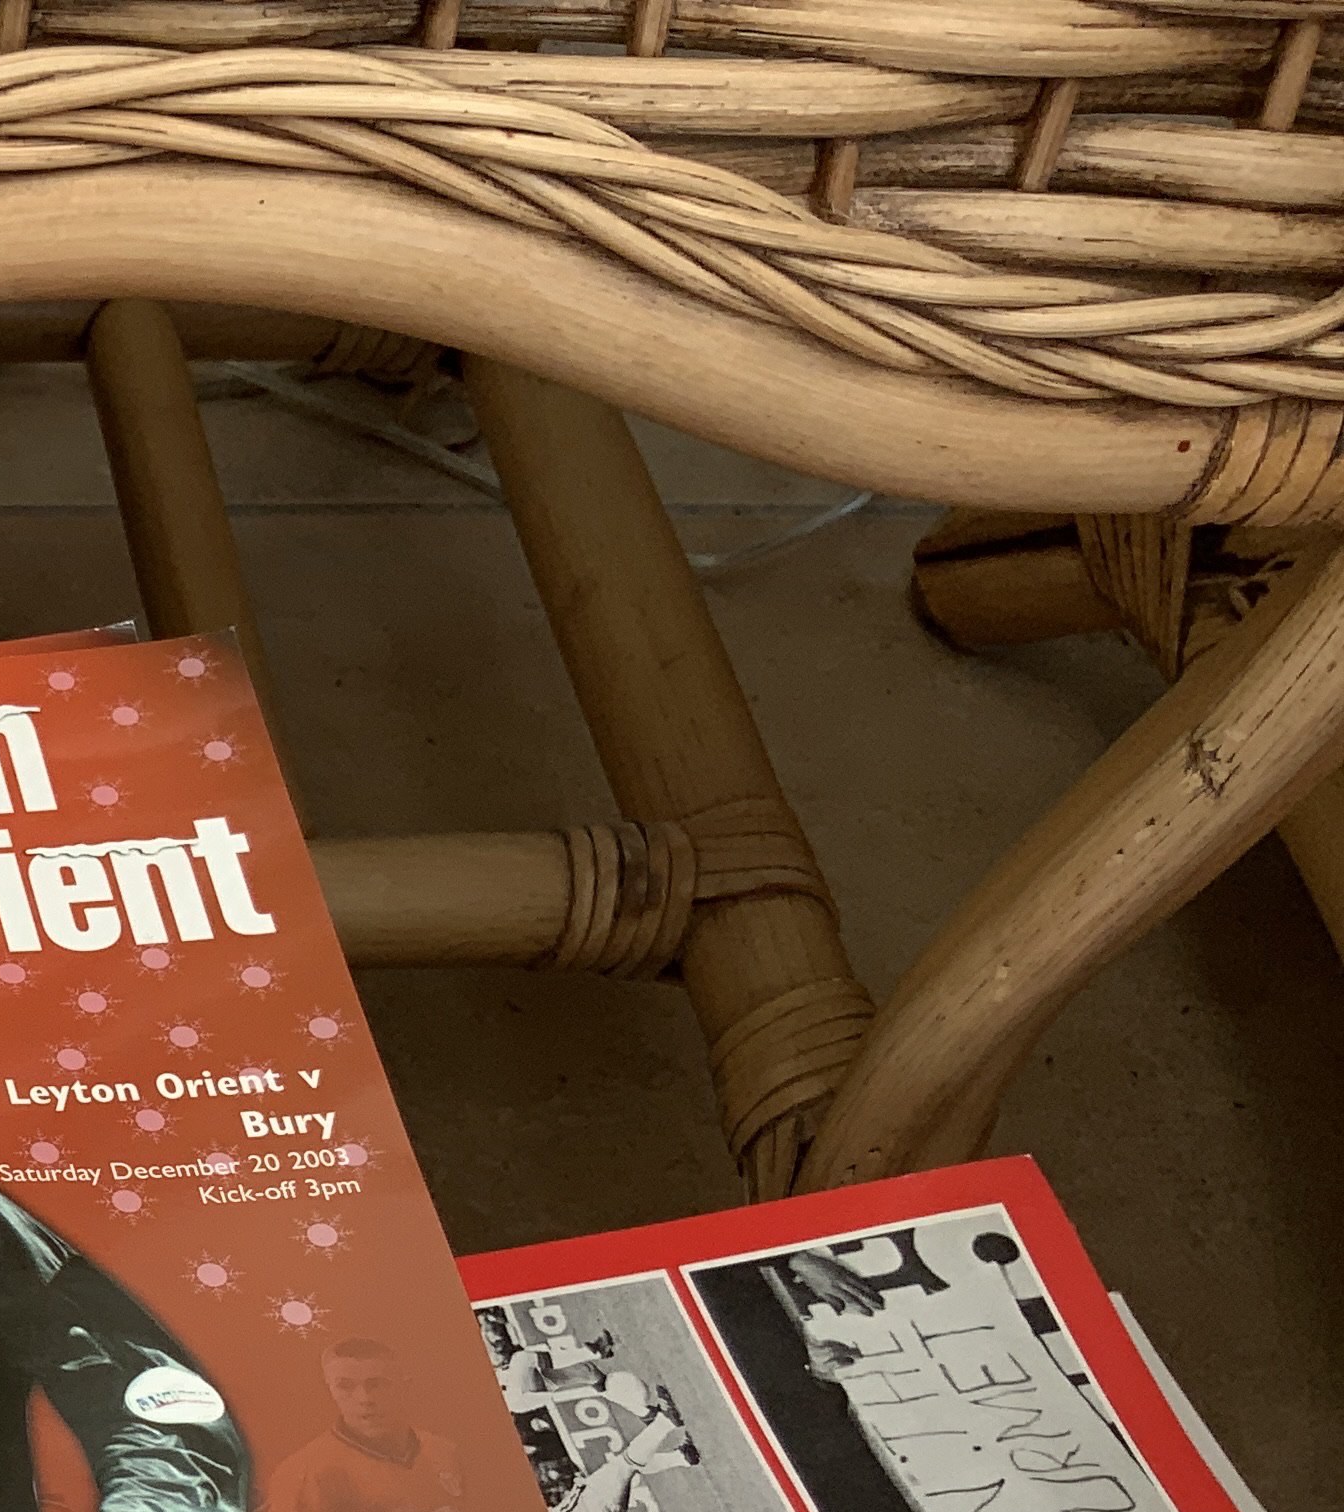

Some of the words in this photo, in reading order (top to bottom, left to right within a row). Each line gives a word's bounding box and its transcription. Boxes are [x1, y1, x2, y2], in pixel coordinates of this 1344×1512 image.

[4, 1077, 140, 1112] Leyton
[156, 1067, 285, 1100] Orient
[297, 1068, 321, 1089] v
[239, 1108, 337, 1141] Bury
[109, 1157, 241, 1182] December
[247, 1152, 281, 1175] 20
[286, 1147, 351, 1171] 2003
[198, 1180, 298, 1205] Kick-off
[303, 1176, 362, 1200] 3pm
